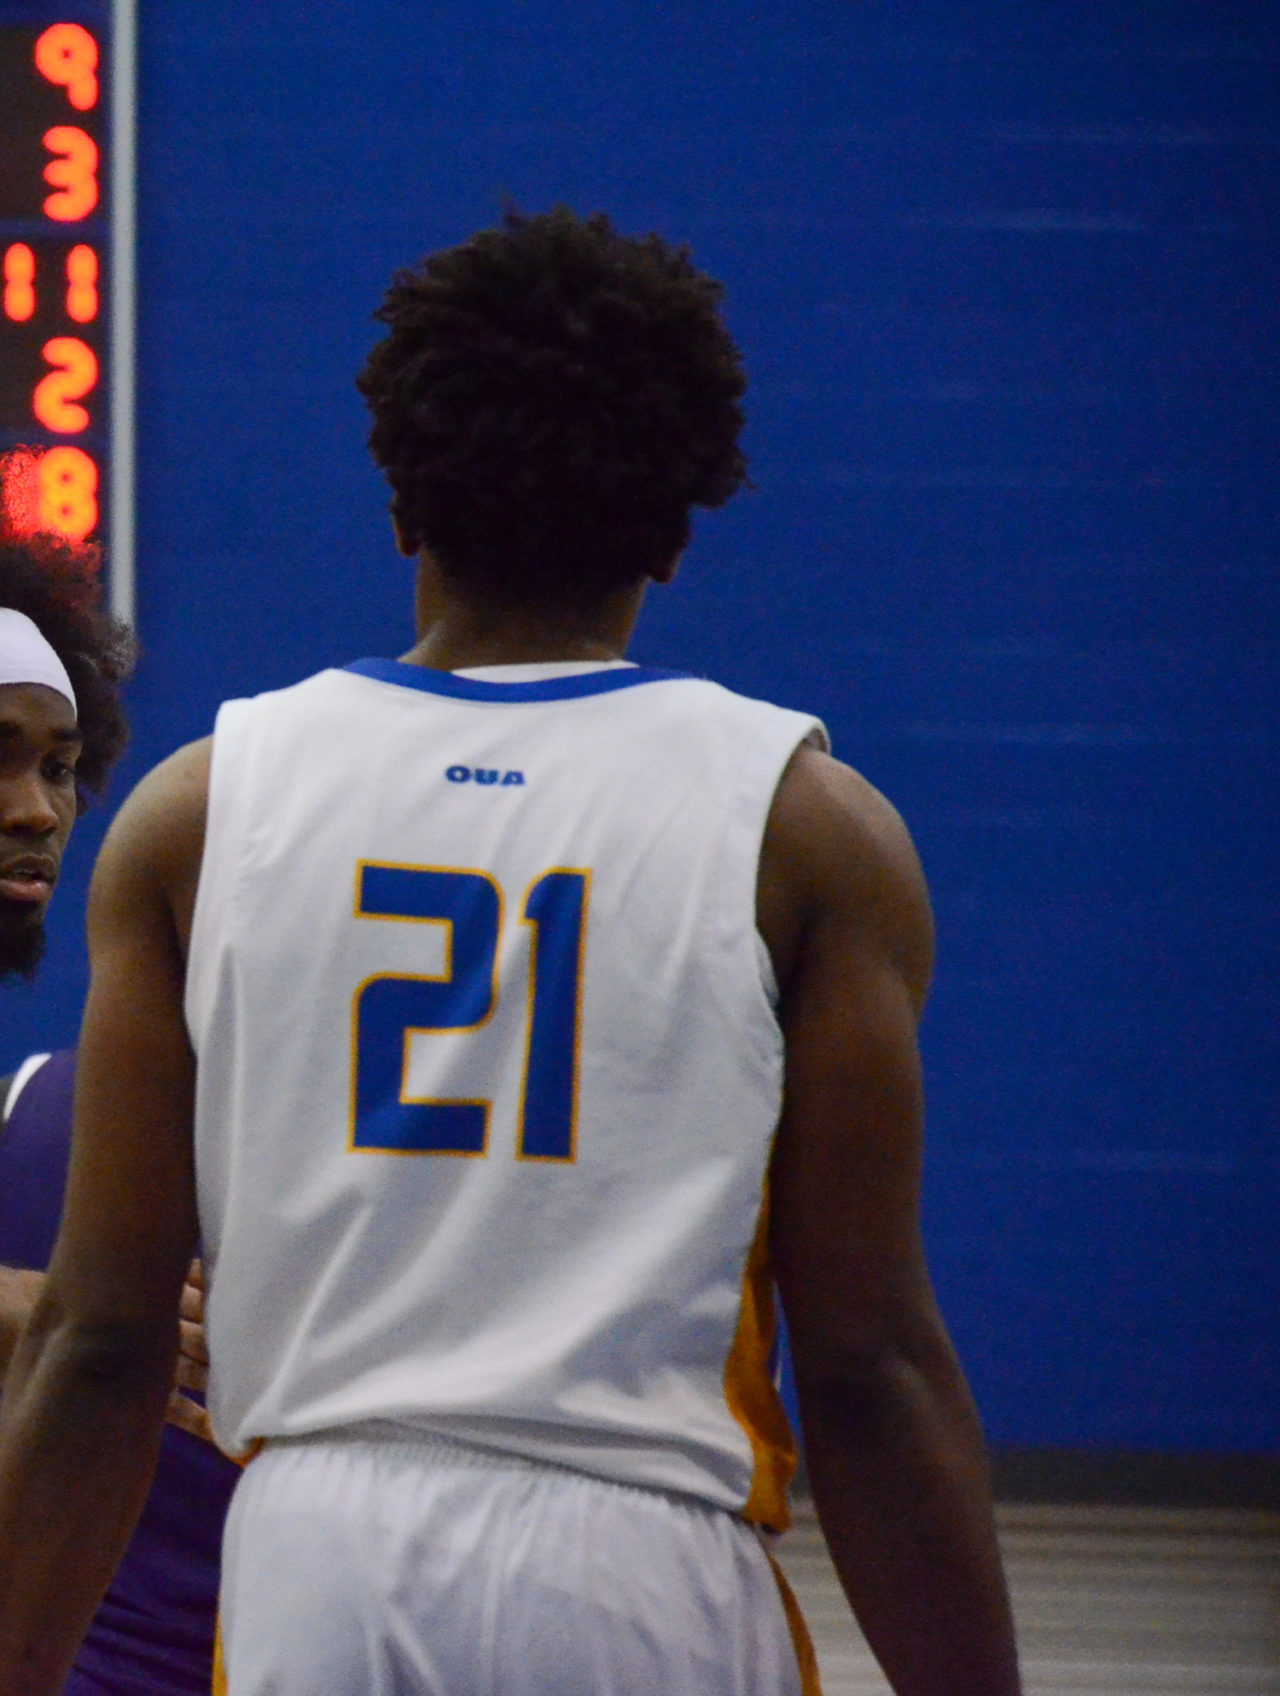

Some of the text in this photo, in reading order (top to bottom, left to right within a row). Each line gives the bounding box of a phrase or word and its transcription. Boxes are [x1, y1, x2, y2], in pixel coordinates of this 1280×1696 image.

[35, 23, 98, 110] 9
[43, 126, 98, 222] 3
[4, 243, 98, 323] 11
[33, 337, 98, 434] 2
[445, 765, 525, 786] OUA
[347, 858, 593, 1163] 21
